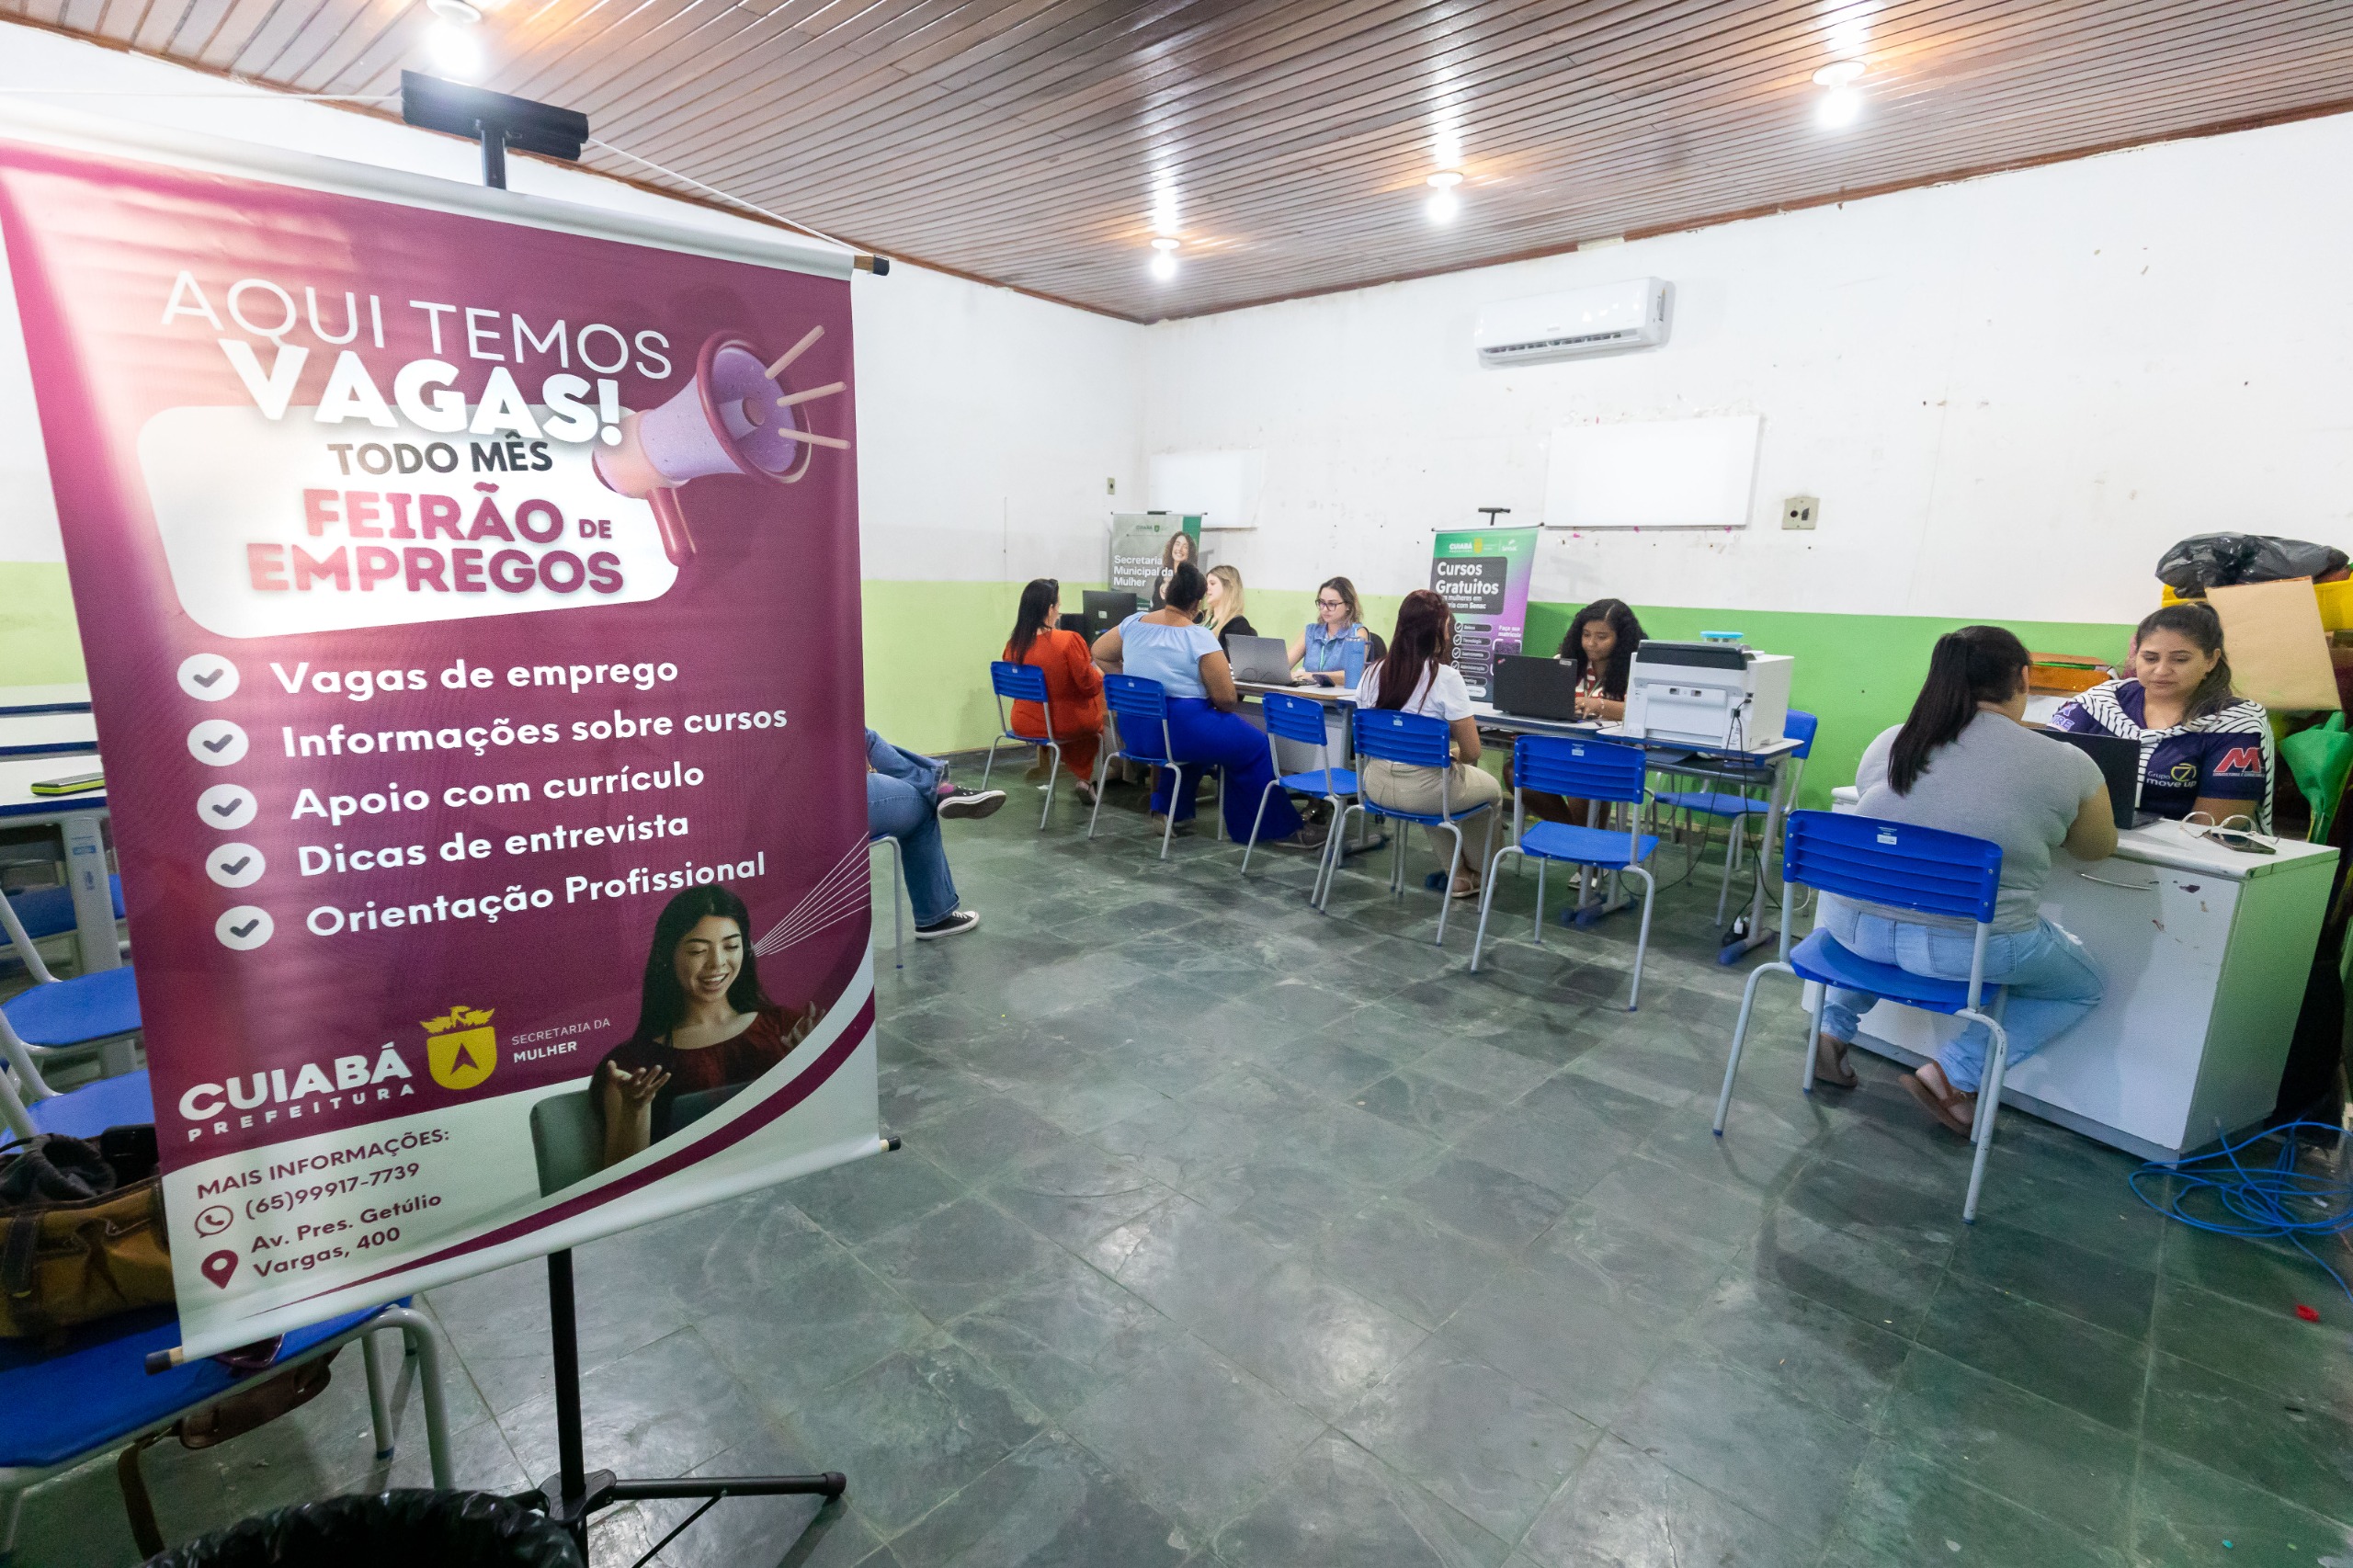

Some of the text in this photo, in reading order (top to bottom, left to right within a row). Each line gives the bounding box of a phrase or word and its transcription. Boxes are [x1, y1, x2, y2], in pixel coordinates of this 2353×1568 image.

[161, 269, 672, 380] AQUI TEMOS
[217, 338, 622, 447] VAGAS!
[327, 432, 551, 475] TODO MÊS
[302, 482, 612, 543] FEIRÃO DE
[245, 543, 624, 595] EMPREGOS
[1114, 555, 1163, 564] Secretaria
[1114, 566, 1174, 578] Municipal da
[1114, 577, 1146, 586] Mulher
[1437, 562, 1483, 575] Cursos
[1436, 578, 1499, 595] Gratuitos
[270, 658, 678, 701] Vagas de emprego
[282, 705, 787, 757] Informações sobre cursos
[290, 762, 704, 825] Apoio com currículo
[2146, 778, 2182, 788] move
[2147, 771, 2171, 779] Grupo
[299, 813, 688, 875] Dicas de entrevista
[306, 852, 765, 936] Orientação Profissional
[511, 1017, 610, 1046] SECRETARIA DA
[513, 1041, 577, 1063] MULHER
[178, 1041, 413, 1121] CUIABÁ
[188, 1085, 415, 1142] PREFEITURA
[197, 1129, 449, 1199] MAIS INFORMAÇÕES:
[245, 1163, 419, 1221] (65)99917-7739
[250, 1194, 442, 1254] Av. Pres. Getúlio
[253, 1227, 400, 1278] Vargas, 400
